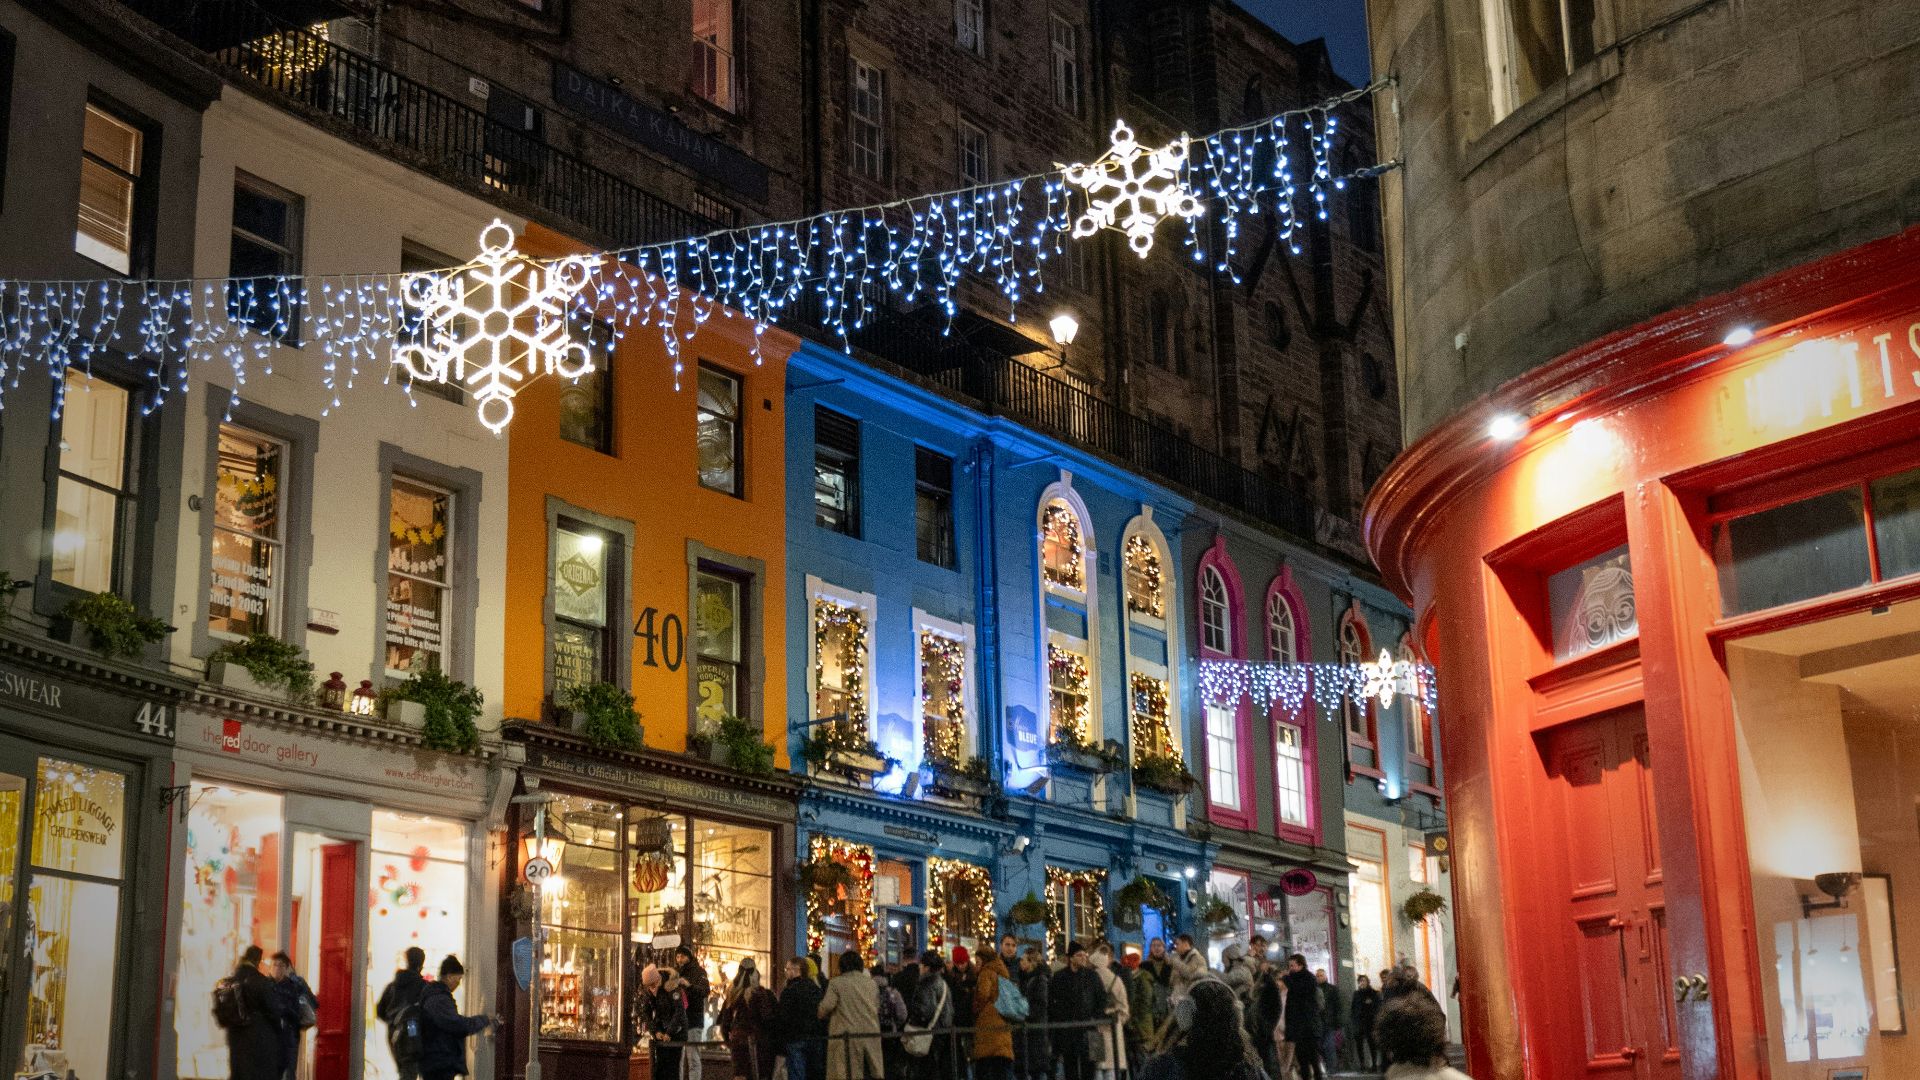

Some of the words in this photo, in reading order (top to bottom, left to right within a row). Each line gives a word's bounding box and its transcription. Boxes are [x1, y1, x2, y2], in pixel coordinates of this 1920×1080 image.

[242, 560, 268, 580] Local
[239, 595, 264, 616] 2003
[554, 641, 593, 659] WORLD
[633, 606, 684, 673] 40
[554, 653, 593, 670] AMOUS
[203, 727, 222, 744] the
[223, 732, 240, 749] red
[243, 734, 272, 755] door
[276, 743, 318, 767] gallery
[1018, 730, 1038, 745] BLEUE
[384, 766, 475, 791] www.edinburghart.com
[542, 754, 575, 773] Retailer
[576, 763, 585, 775] of
[588, 764, 626, 783] Officially
[627, 771, 661, 790] Licensed
[663, 779, 694, 797] HARRY
[695, 786, 731, 804] POTTER
[733, 792, 778, 813] Merchandise
[40, 796, 76, 823] TWEED
[79, 797, 116, 836] LUGGAGE
[528, 864, 550, 879] 20
[1674, 973, 1709, 1002] 92
